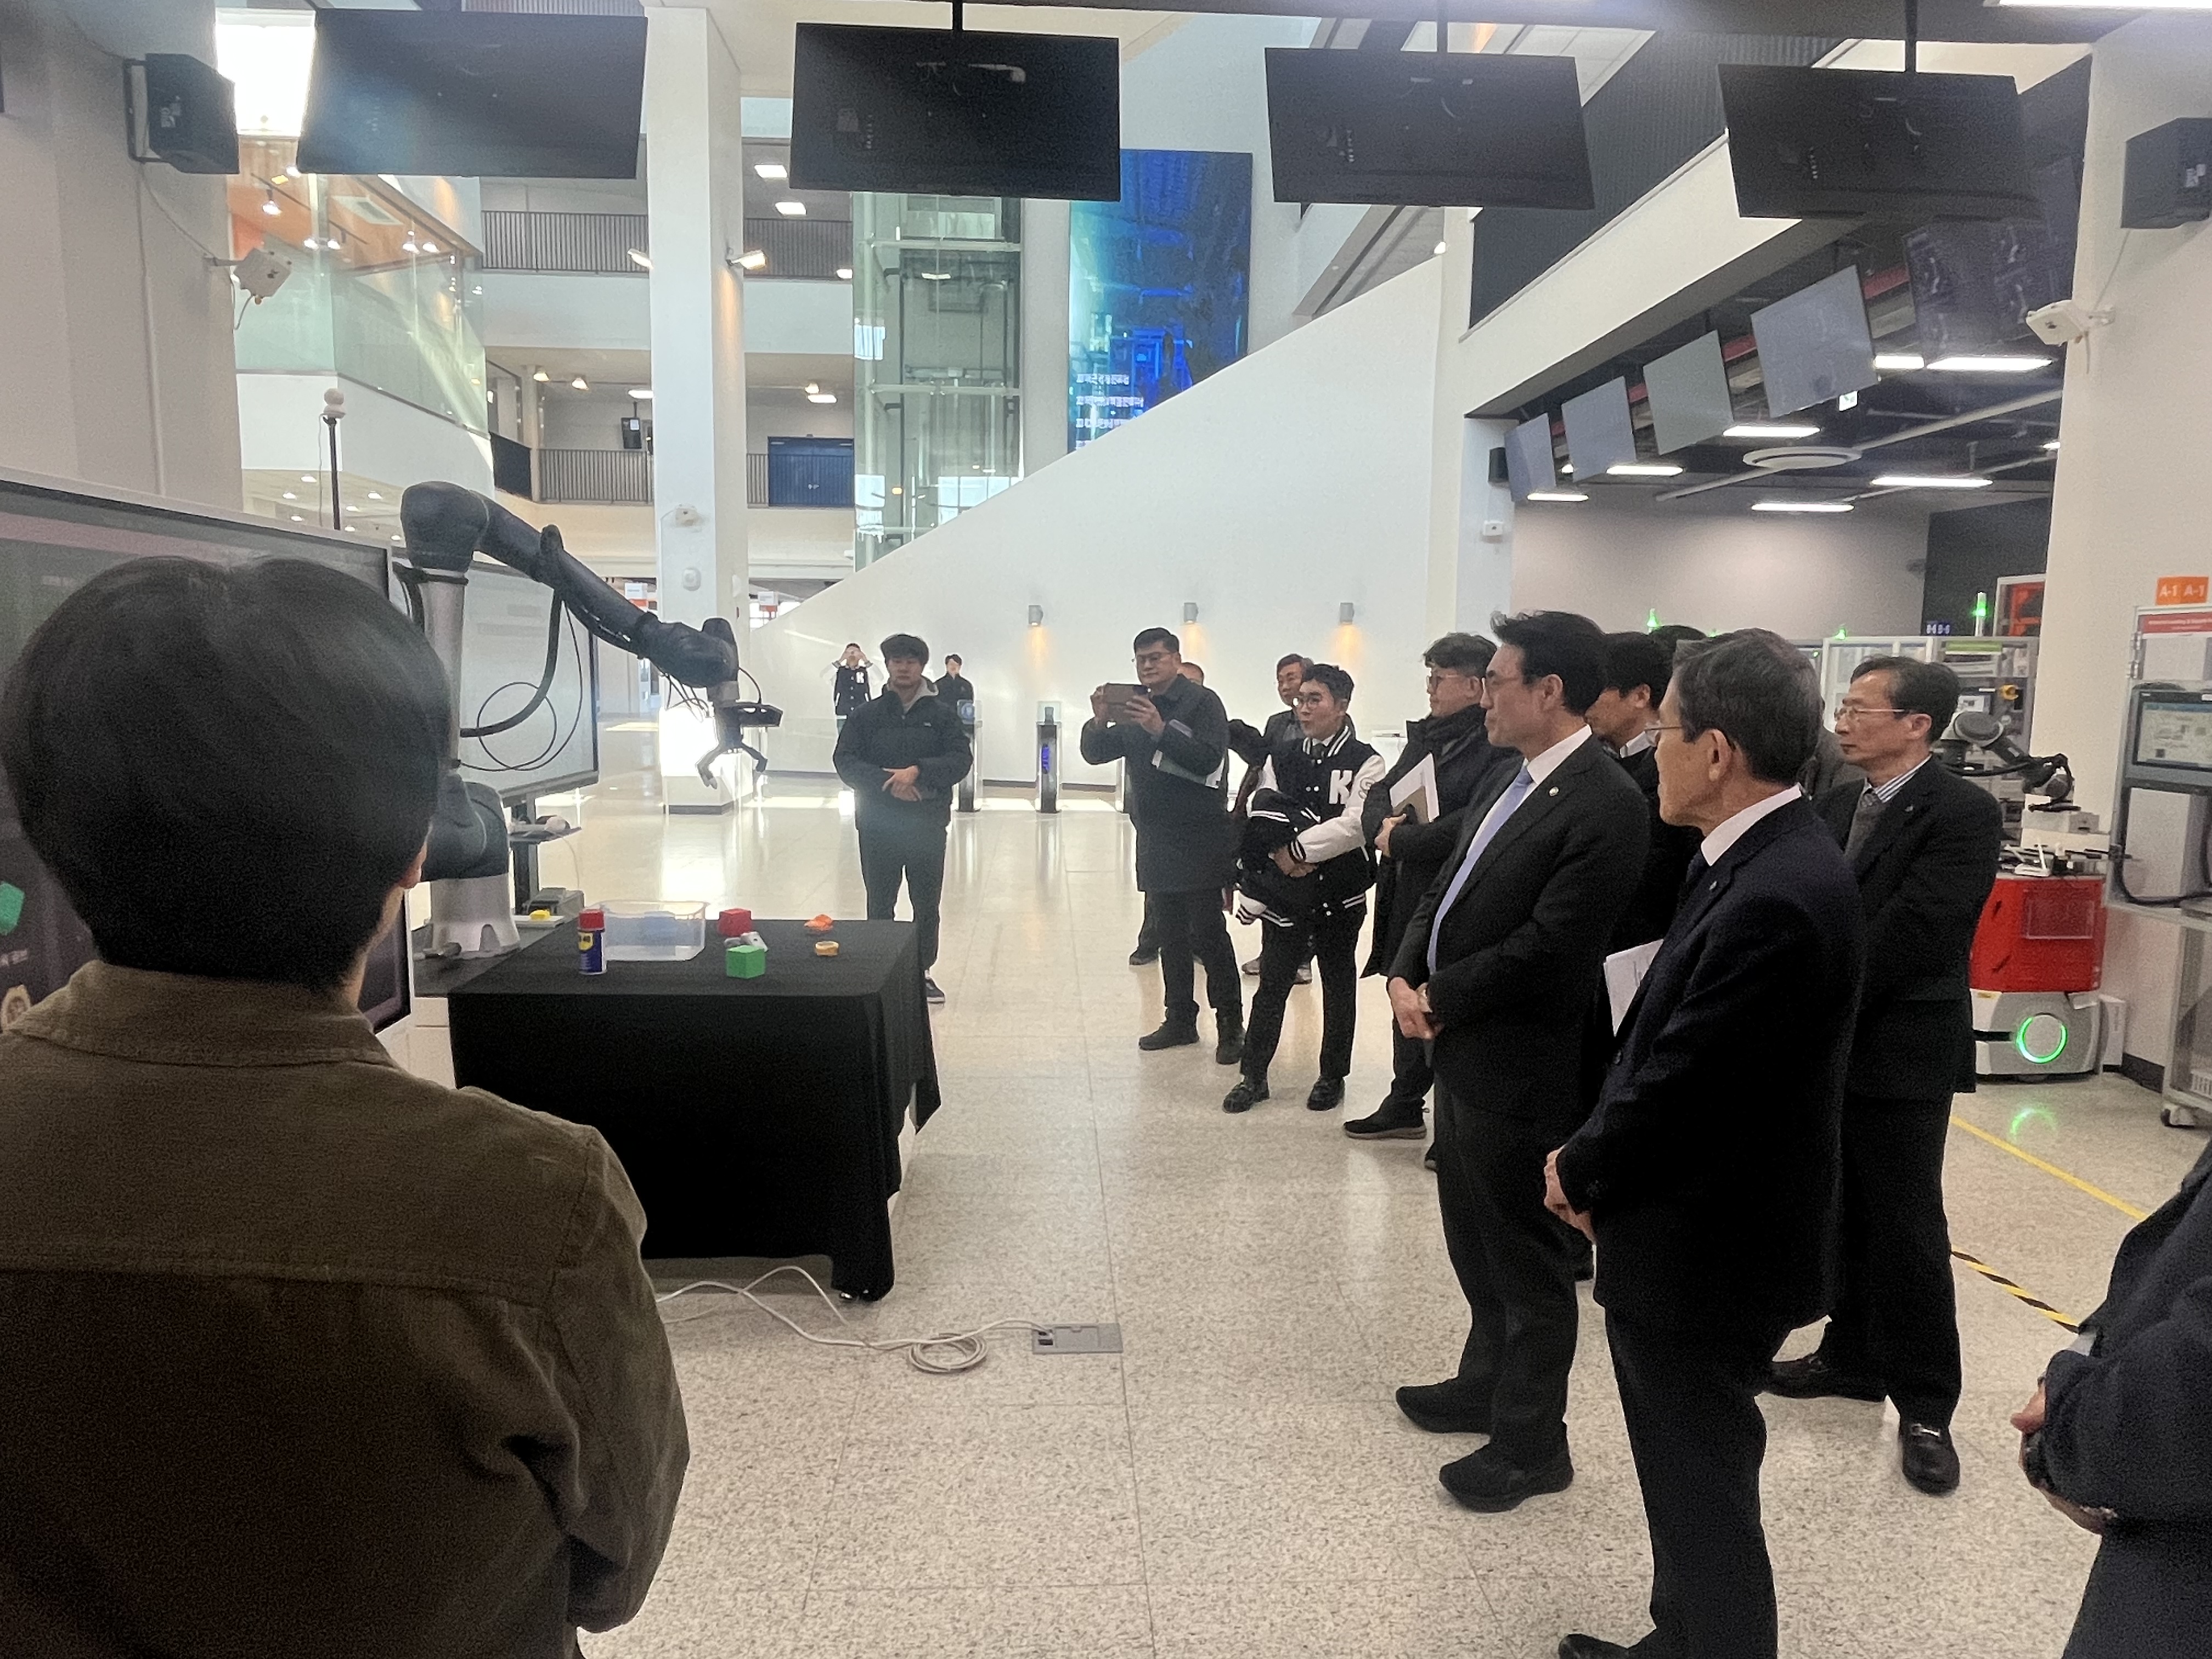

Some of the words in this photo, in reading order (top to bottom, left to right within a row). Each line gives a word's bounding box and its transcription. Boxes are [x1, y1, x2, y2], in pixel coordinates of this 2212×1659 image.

[2159, 584, 2177, 597] A-1
[2183, 584, 2205, 597] A-1
[1329, 769, 1353, 804] K
